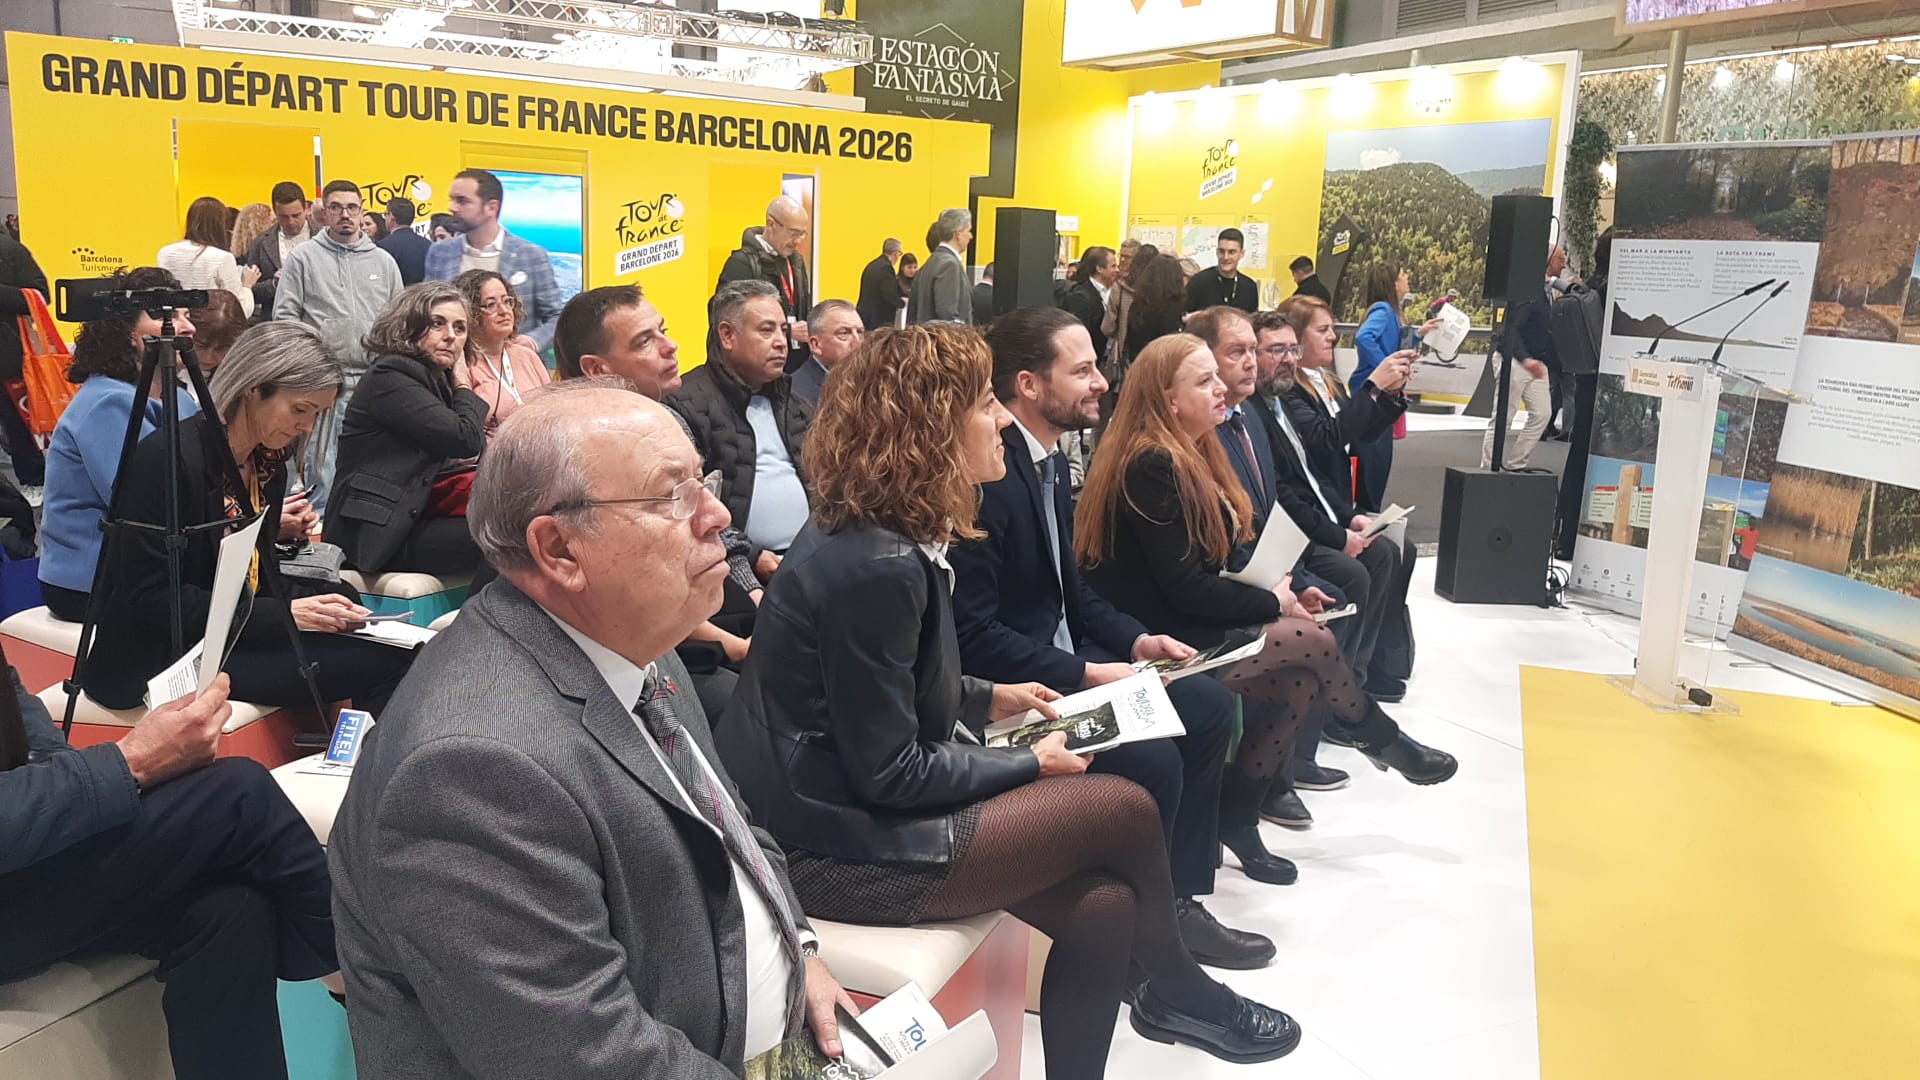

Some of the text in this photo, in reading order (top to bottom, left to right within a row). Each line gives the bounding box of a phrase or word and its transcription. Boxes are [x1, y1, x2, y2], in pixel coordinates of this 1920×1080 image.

[880, 36, 1000, 75] ESTACIÓN
[872, 62, 1004, 102] FANTASMA
[41, 53, 913, 162] GRAND DÉPART TOUR DE FRANCE BARCELONA 2026
[905, 94, 914, 103] EL
[915, 95, 941, 105] SECRETO
[942, 98, 950, 106] DE
[615, 216, 684, 248] france
[80, 254, 123, 263] Barcelona
[620, 248, 680, 273] BARCELONE 2026
[621, 246, 648, 262] GRAND
[336, 716, 360, 758] FITEL
